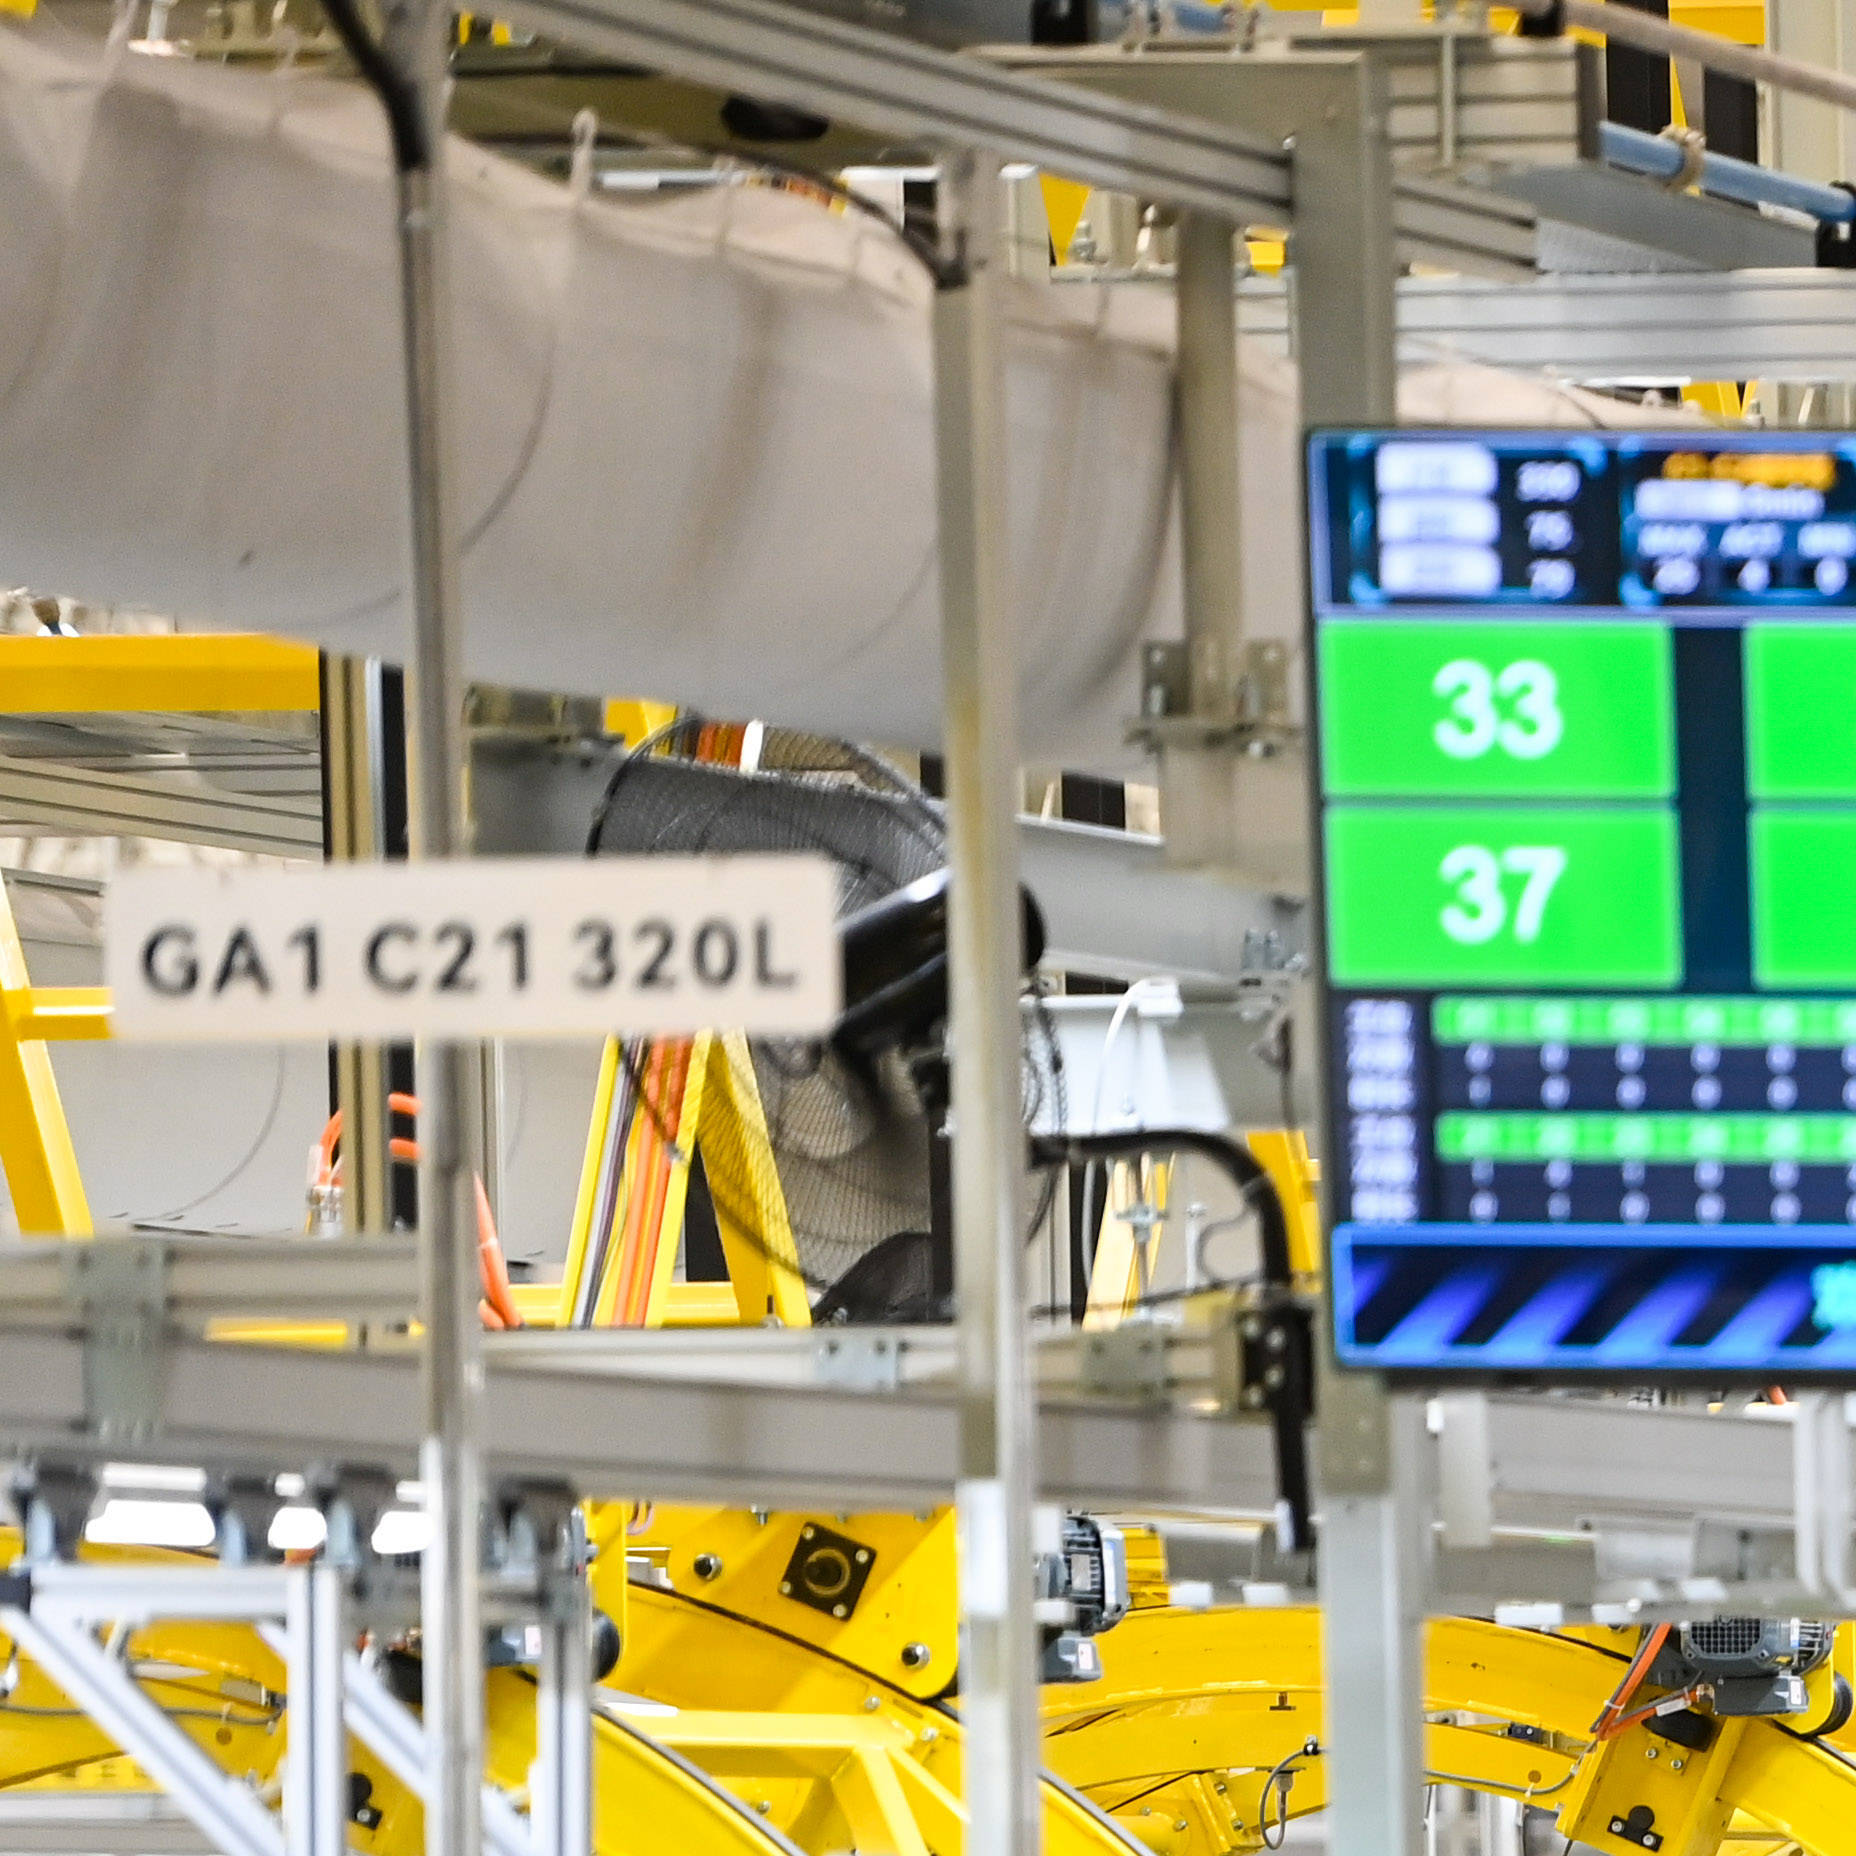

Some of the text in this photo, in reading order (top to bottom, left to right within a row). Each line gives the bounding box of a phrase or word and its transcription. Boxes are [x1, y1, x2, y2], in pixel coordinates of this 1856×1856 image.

[1431, 659, 1563, 759] 33
[1438, 844, 1567, 945] 37
[141, 917, 797, 997] GA1 C21 320L
